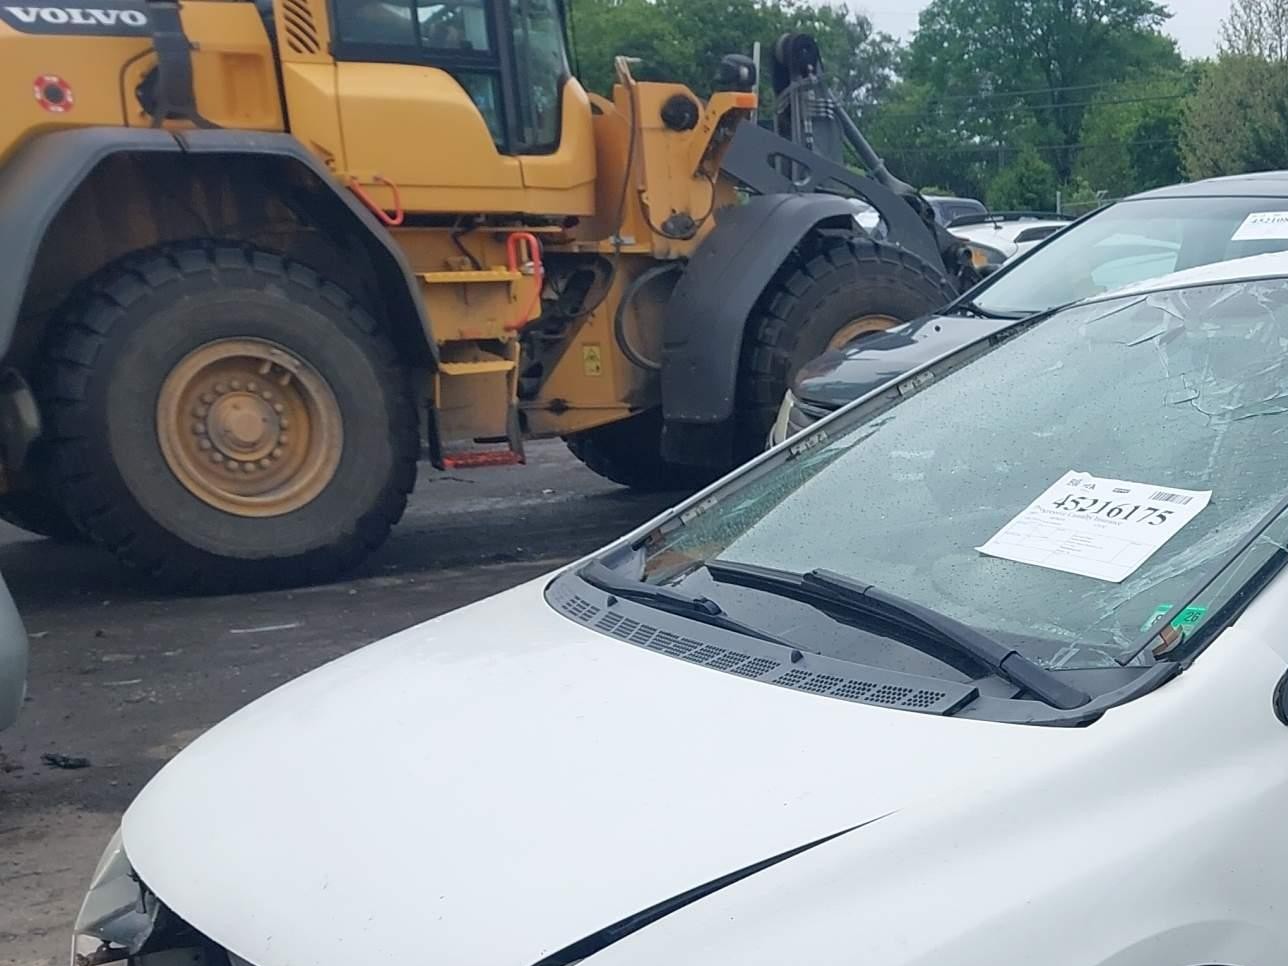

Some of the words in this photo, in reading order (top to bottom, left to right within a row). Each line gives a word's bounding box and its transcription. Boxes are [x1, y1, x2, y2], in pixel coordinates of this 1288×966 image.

[4, 6, 148, 27] VOLVO
[1052, 493, 1175, 526] 45216175
[1184, 611, 1201, 623] 26
